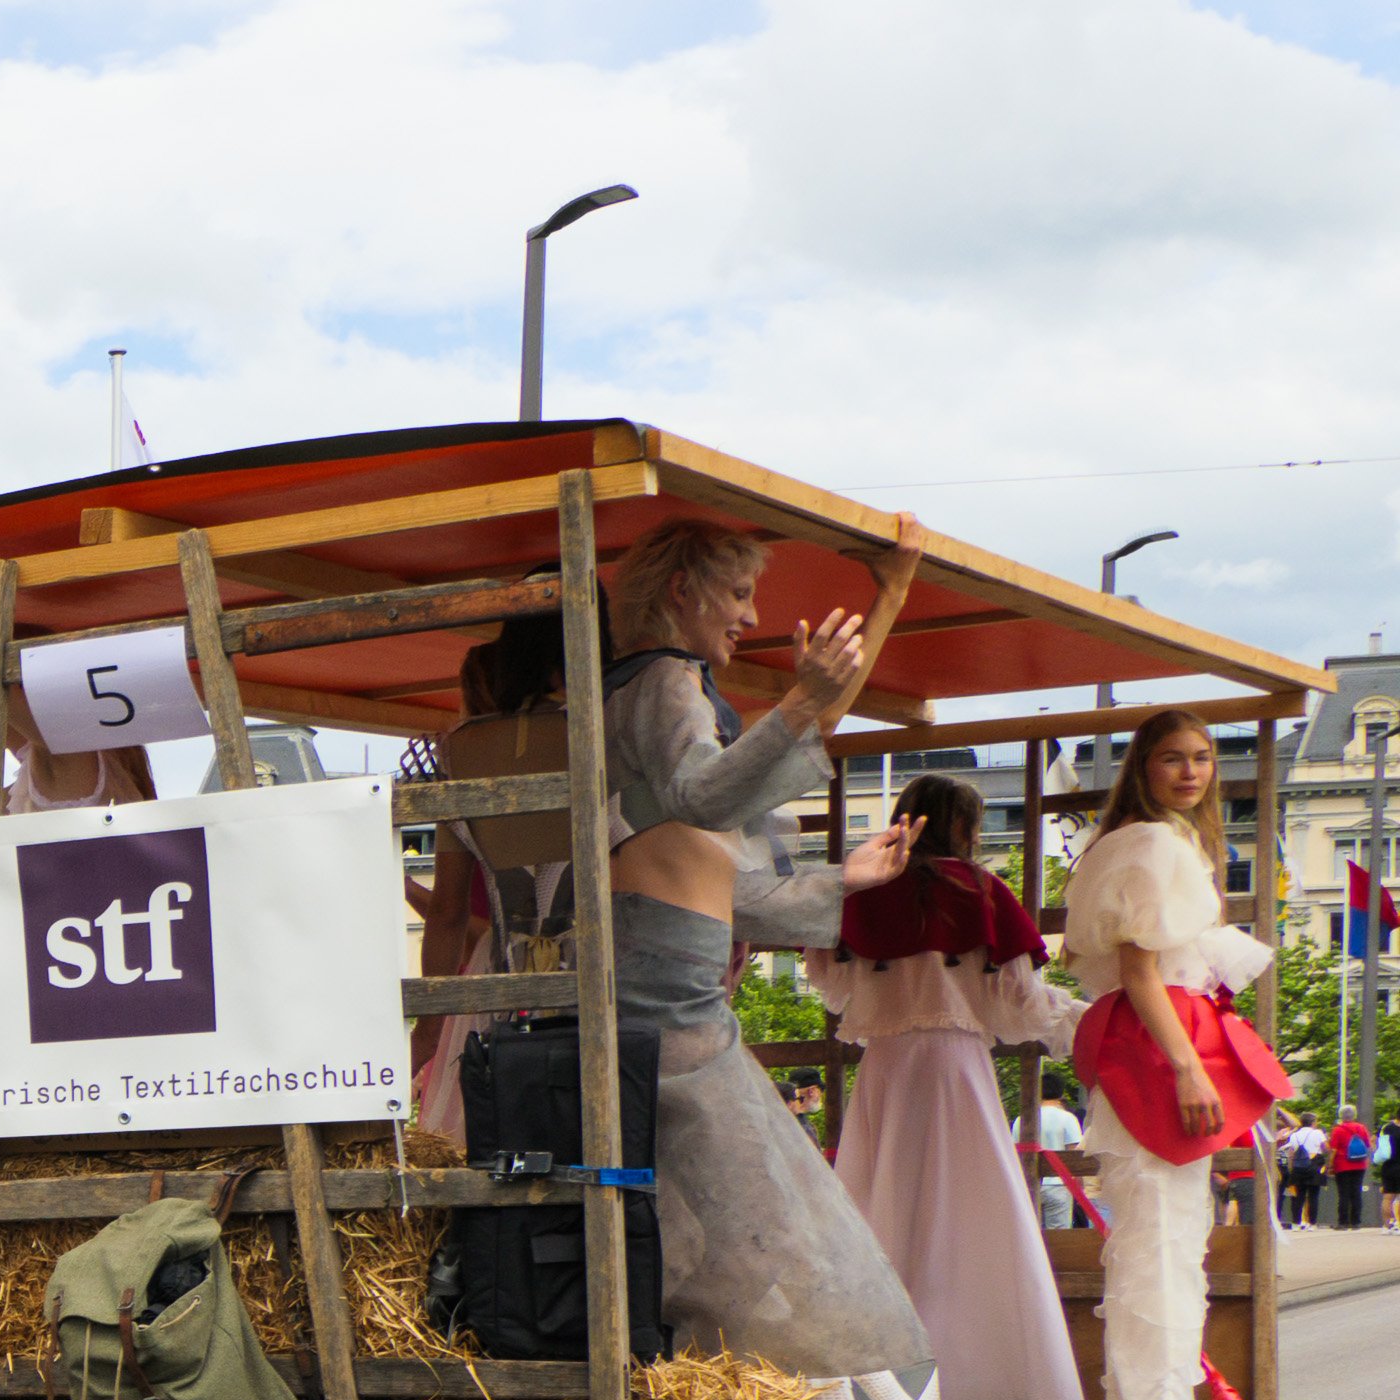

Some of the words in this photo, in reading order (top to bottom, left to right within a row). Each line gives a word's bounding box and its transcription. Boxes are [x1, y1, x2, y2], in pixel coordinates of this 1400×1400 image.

[86, 664, 136, 727] 5
[46, 881, 193, 989] stf
[120, 1061, 395, 1100] Textilfachschule
